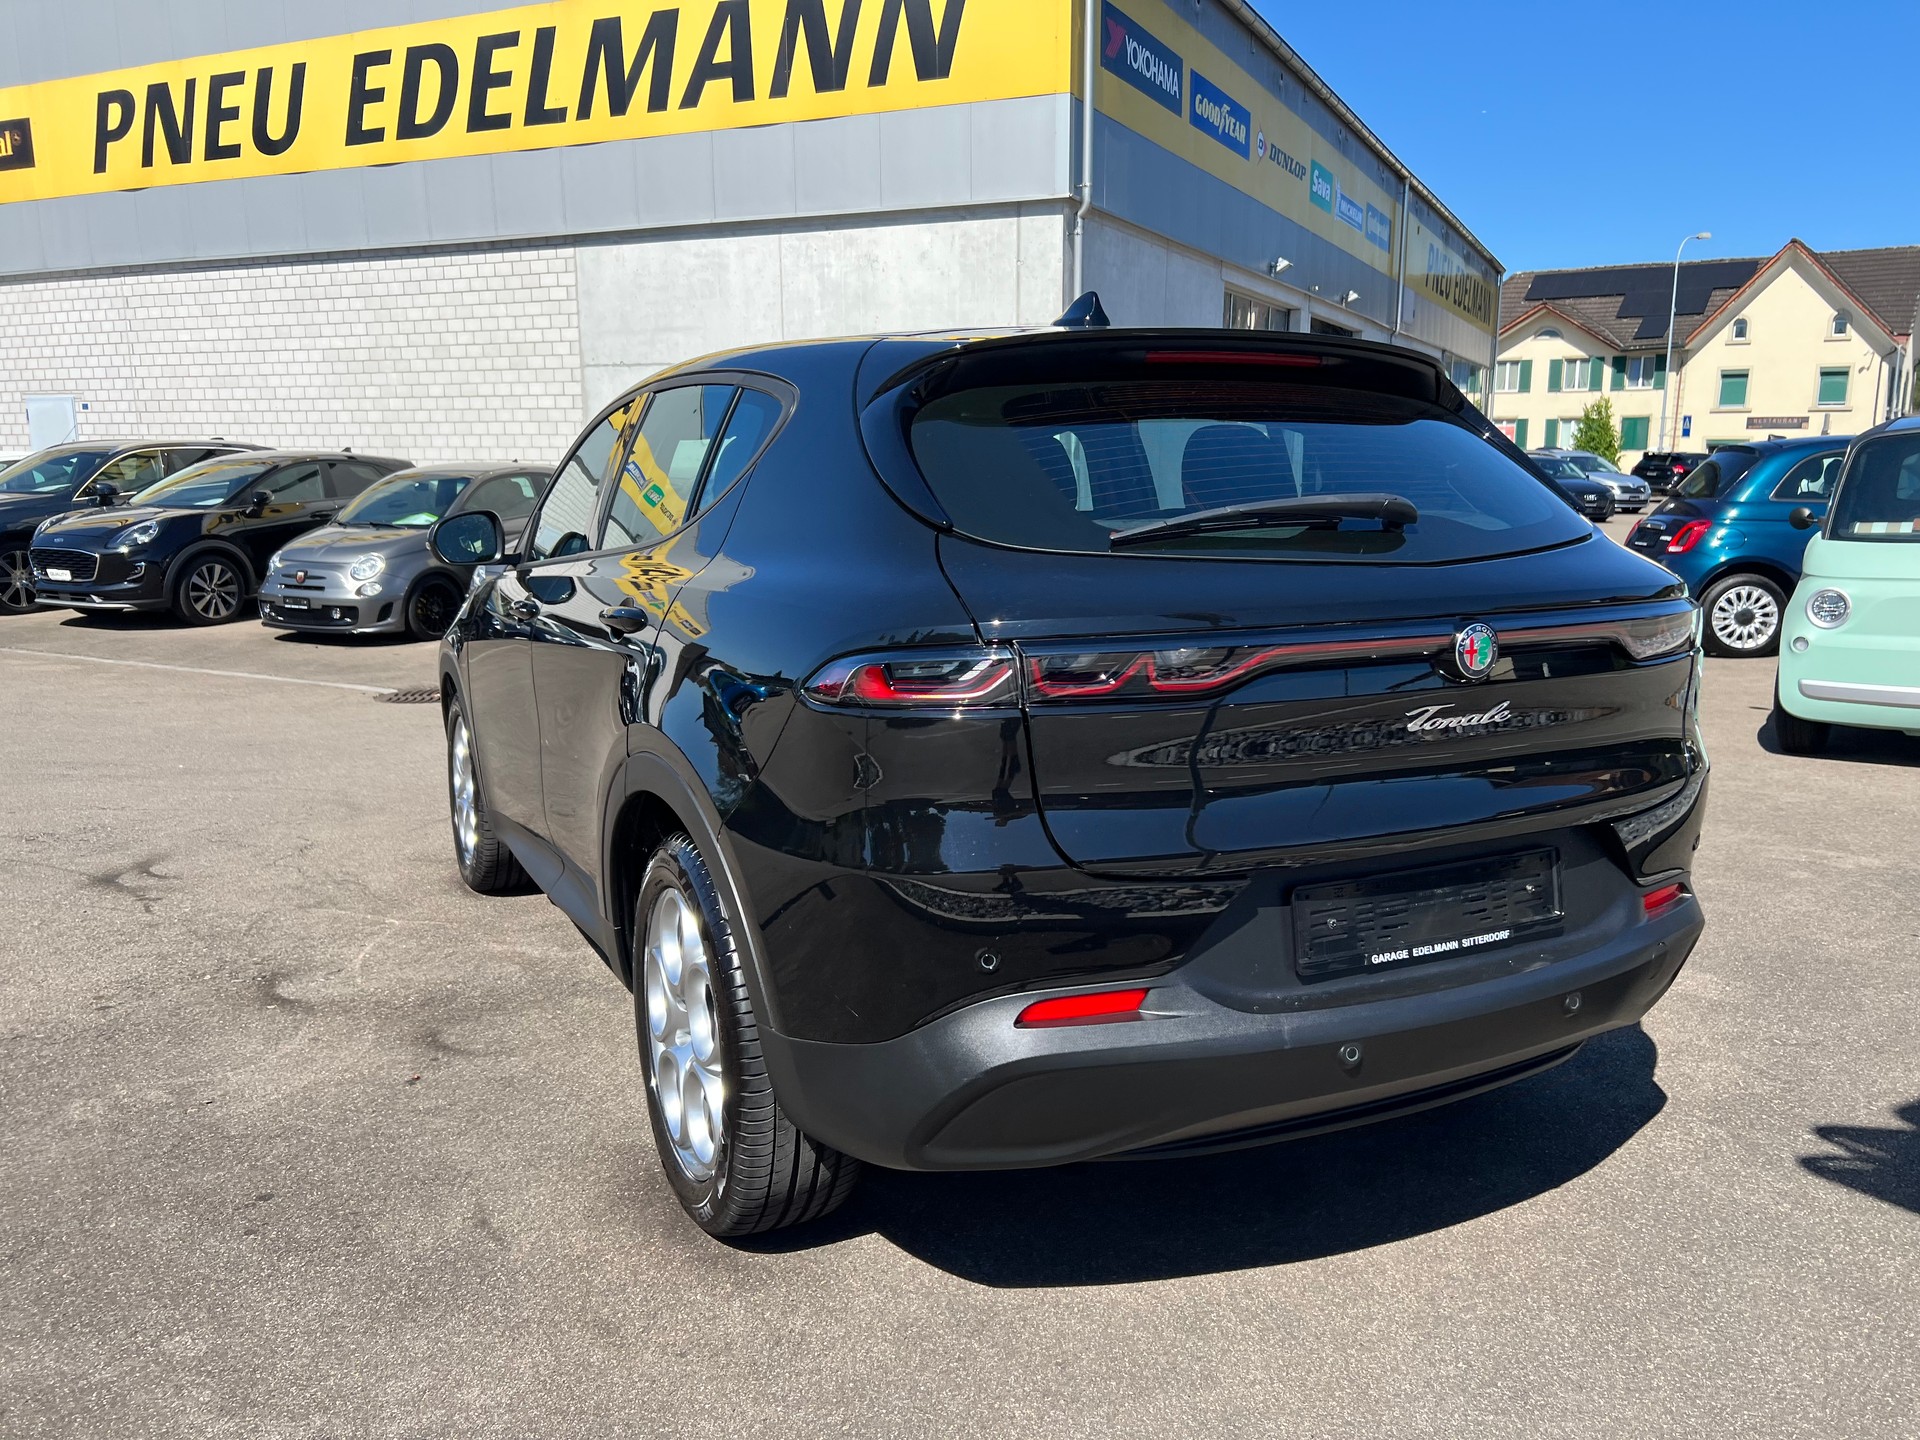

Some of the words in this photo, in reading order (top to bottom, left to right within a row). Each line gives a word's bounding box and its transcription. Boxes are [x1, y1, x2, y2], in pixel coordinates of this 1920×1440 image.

[1125, 34, 1179, 99] YOKOHAMA
[94, 62, 306, 175] PNEU
[345, 0, 965, 148] EDELMANN
[1195, 93, 1247, 145] GOODYEAR
[1269, 142, 1307, 181] DUNLOP
[1312, 169, 1331, 202] Sava
[1425, 242, 1453, 301] PNEU
[1459, 630, 1473, 653] ALFA
[1405, 700, 1512, 732] Tonale
[1371, 949, 1409, 965] GARAGE
[1412, 940, 1459, 957] EDELMANN
[1461, 929, 1510, 948] SITTERDORF
